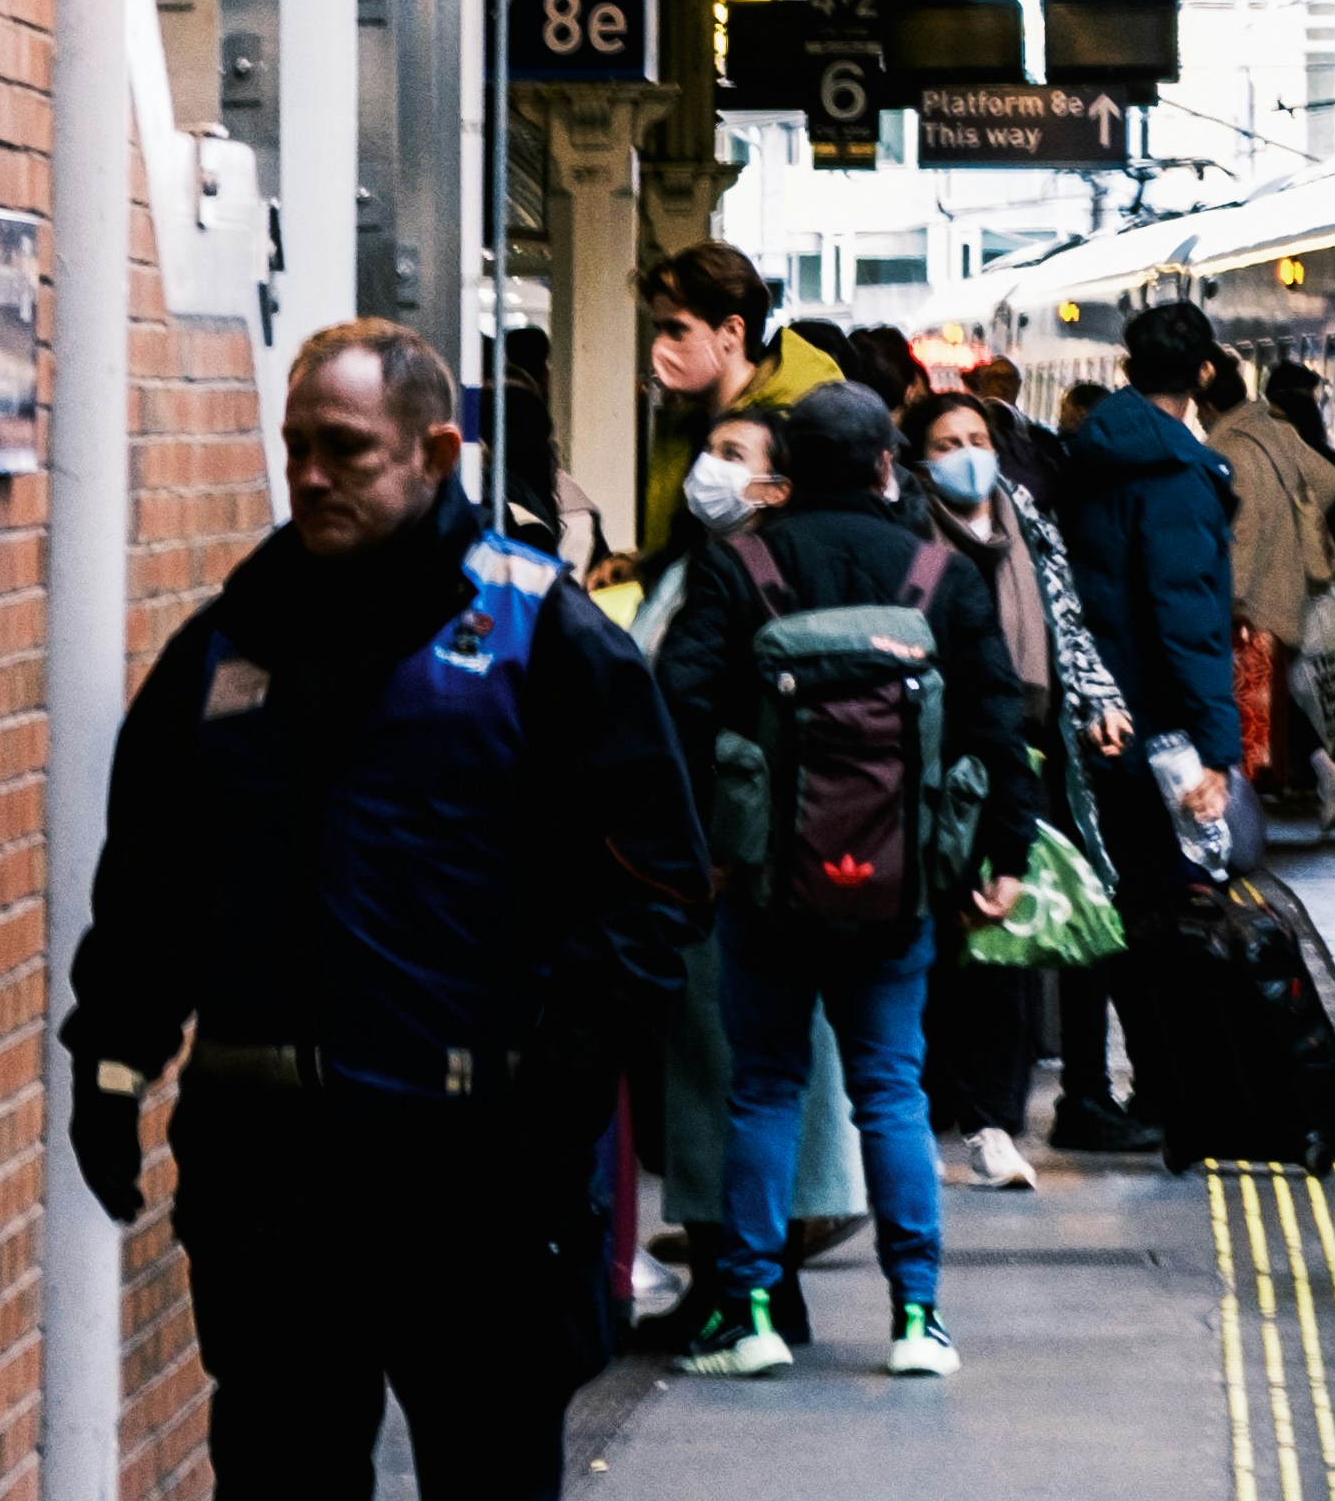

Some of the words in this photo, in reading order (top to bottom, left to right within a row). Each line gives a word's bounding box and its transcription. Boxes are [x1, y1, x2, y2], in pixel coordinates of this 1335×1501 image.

[820, 59, 868, 123] 6
[922, 91, 1045, 117] Platform
[1050, 90, 1084, 116] 8e
[922, 122, 981, 148] This
[986, 128, 1043, 154] way
